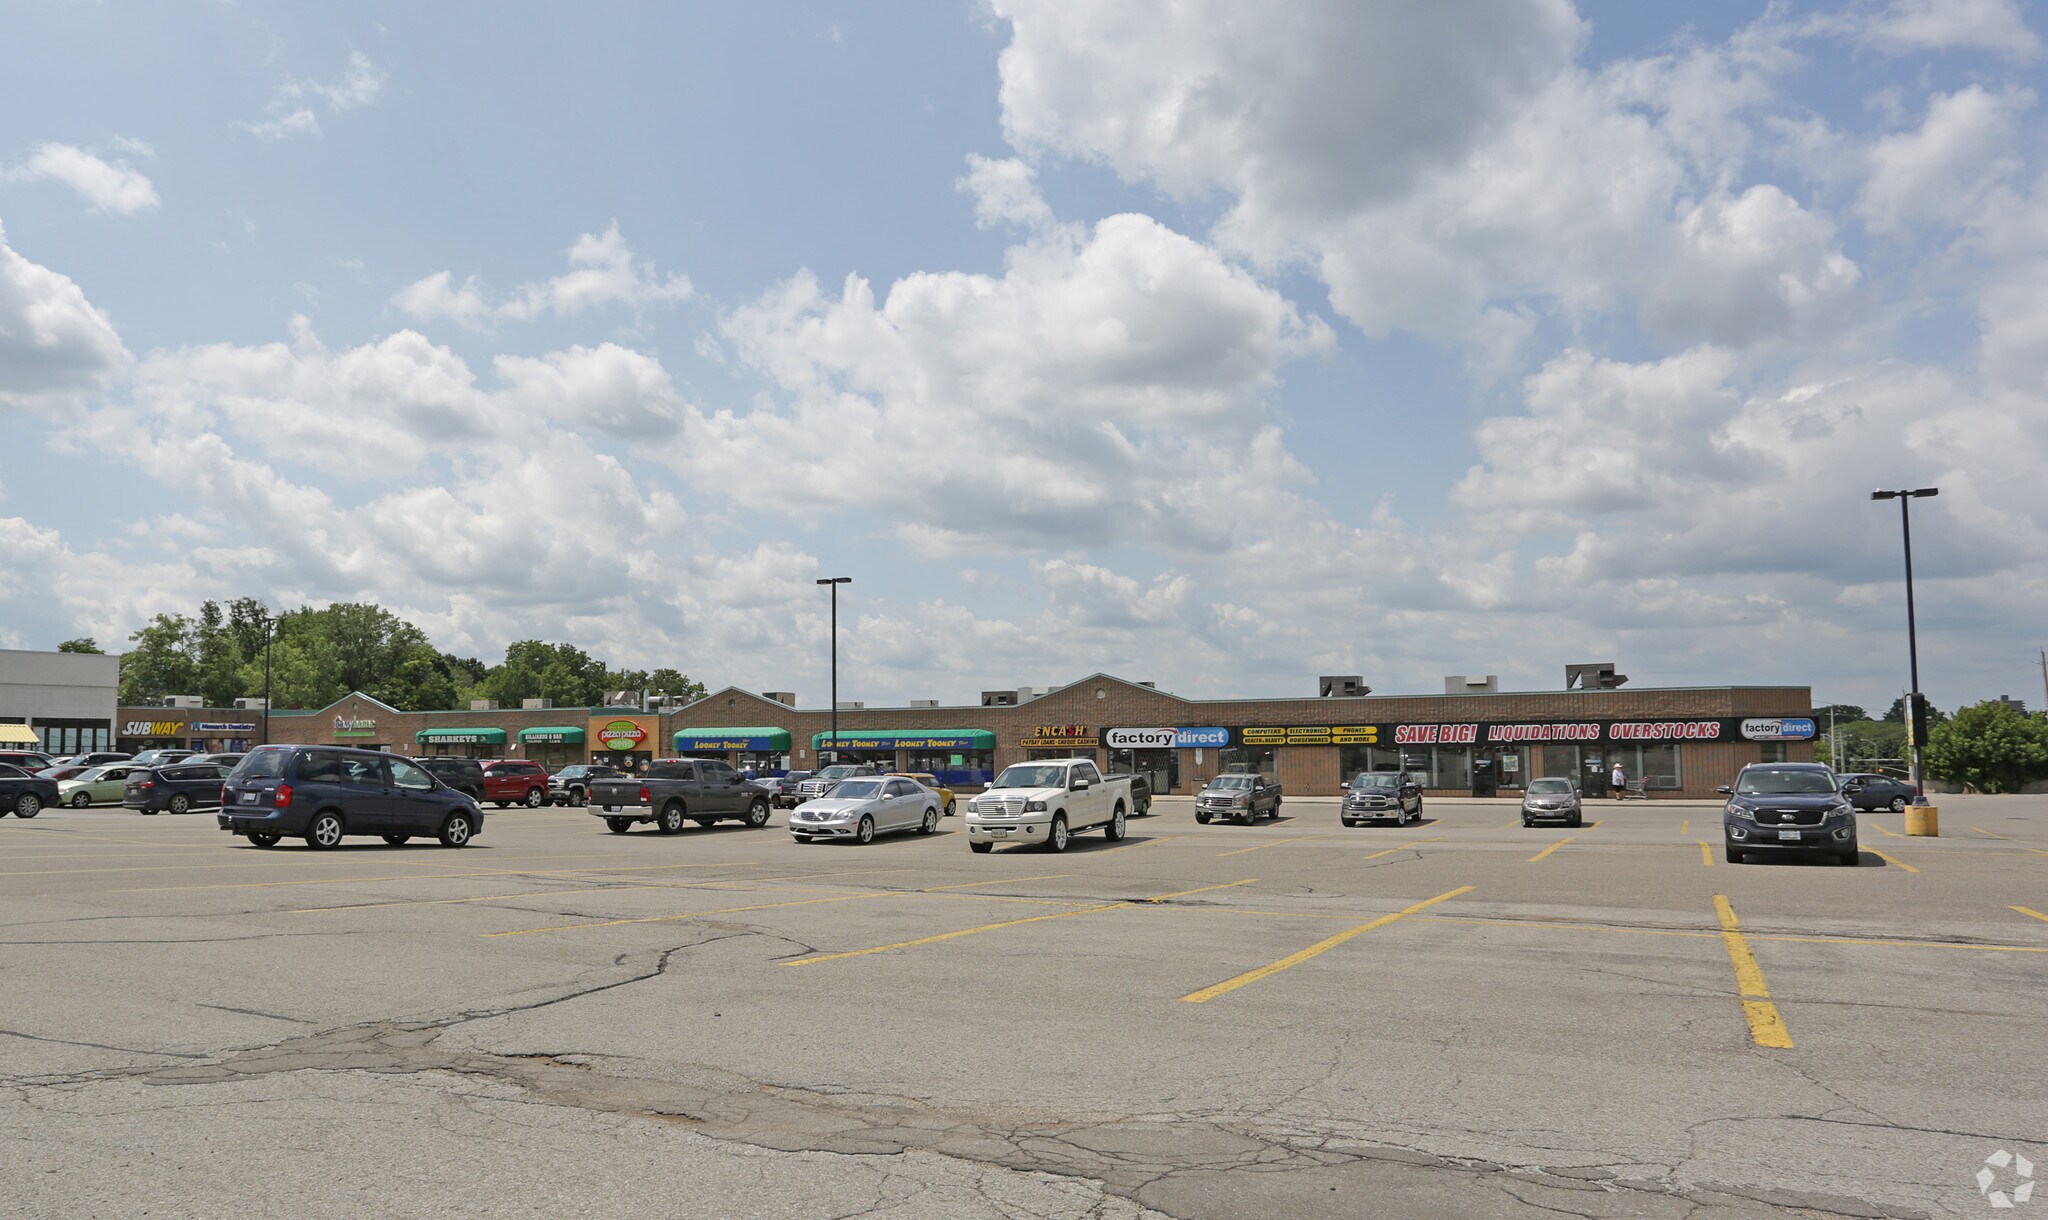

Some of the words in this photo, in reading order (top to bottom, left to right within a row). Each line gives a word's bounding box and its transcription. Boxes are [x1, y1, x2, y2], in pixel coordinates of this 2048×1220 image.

[121, 721, 184, 736] SUBWAY
[602, 731, 620, 739] pizza
[621, 730, 641, 739] pizza
[1395, 725, 1438, 743] SAVE
[1438, 724, 1478, 743] BIG!
[1488, 724, 1601, 741] LIQUIDATIONS
[1609, 722, 1721, 739] OVERSTOCKS
[1745, 723, 1780, 734] factory
[1783, 723, 1812, 732] direct
[428, 735, 477, 743] SHARKEYS
[821, 739, 850, 748] LONEY
[852, 739, 879, 748] TOONEY
[894, 739, 925, 748] LOONEY
[927, 739, 956, 748] TOONEY
[1112, 732, 1173, 746] factory
[1177, 730, 1224, 743] direct
[695, 741, 720, 749] LOONEY
[723, 741, 748, 749] TOONEY
